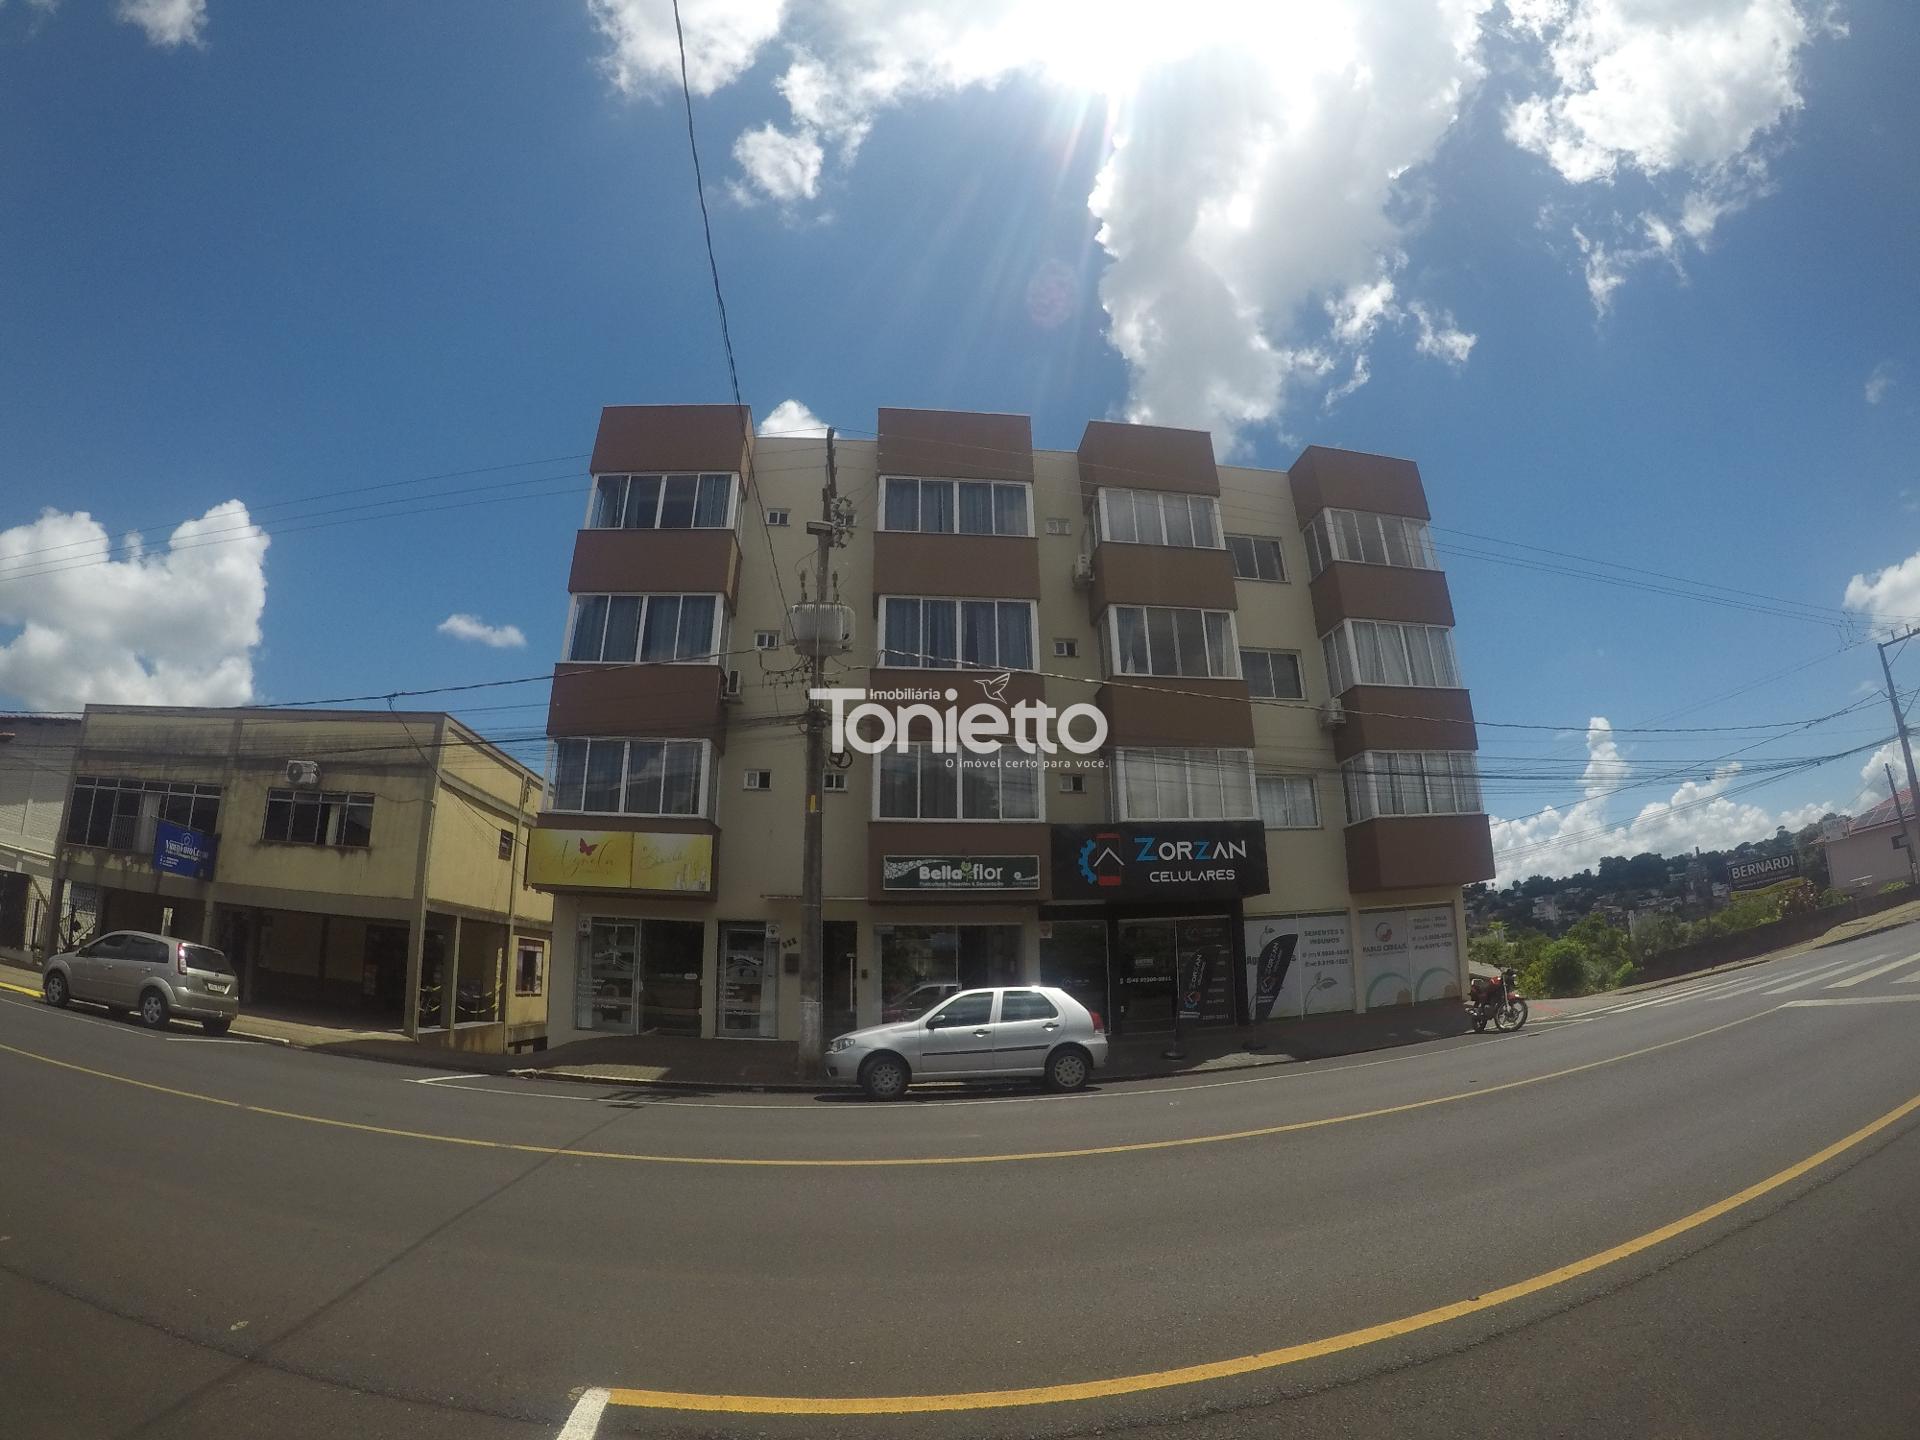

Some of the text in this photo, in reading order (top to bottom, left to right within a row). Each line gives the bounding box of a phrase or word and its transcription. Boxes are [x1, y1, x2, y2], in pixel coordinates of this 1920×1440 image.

[1134, 837, 1247, 862] ZORZAN
[919, 864, 1003, 880] Bella flor
[1149, 869, 1236, 883] CELULARES
[1731, 855, 1795, 879] BERNARDI
